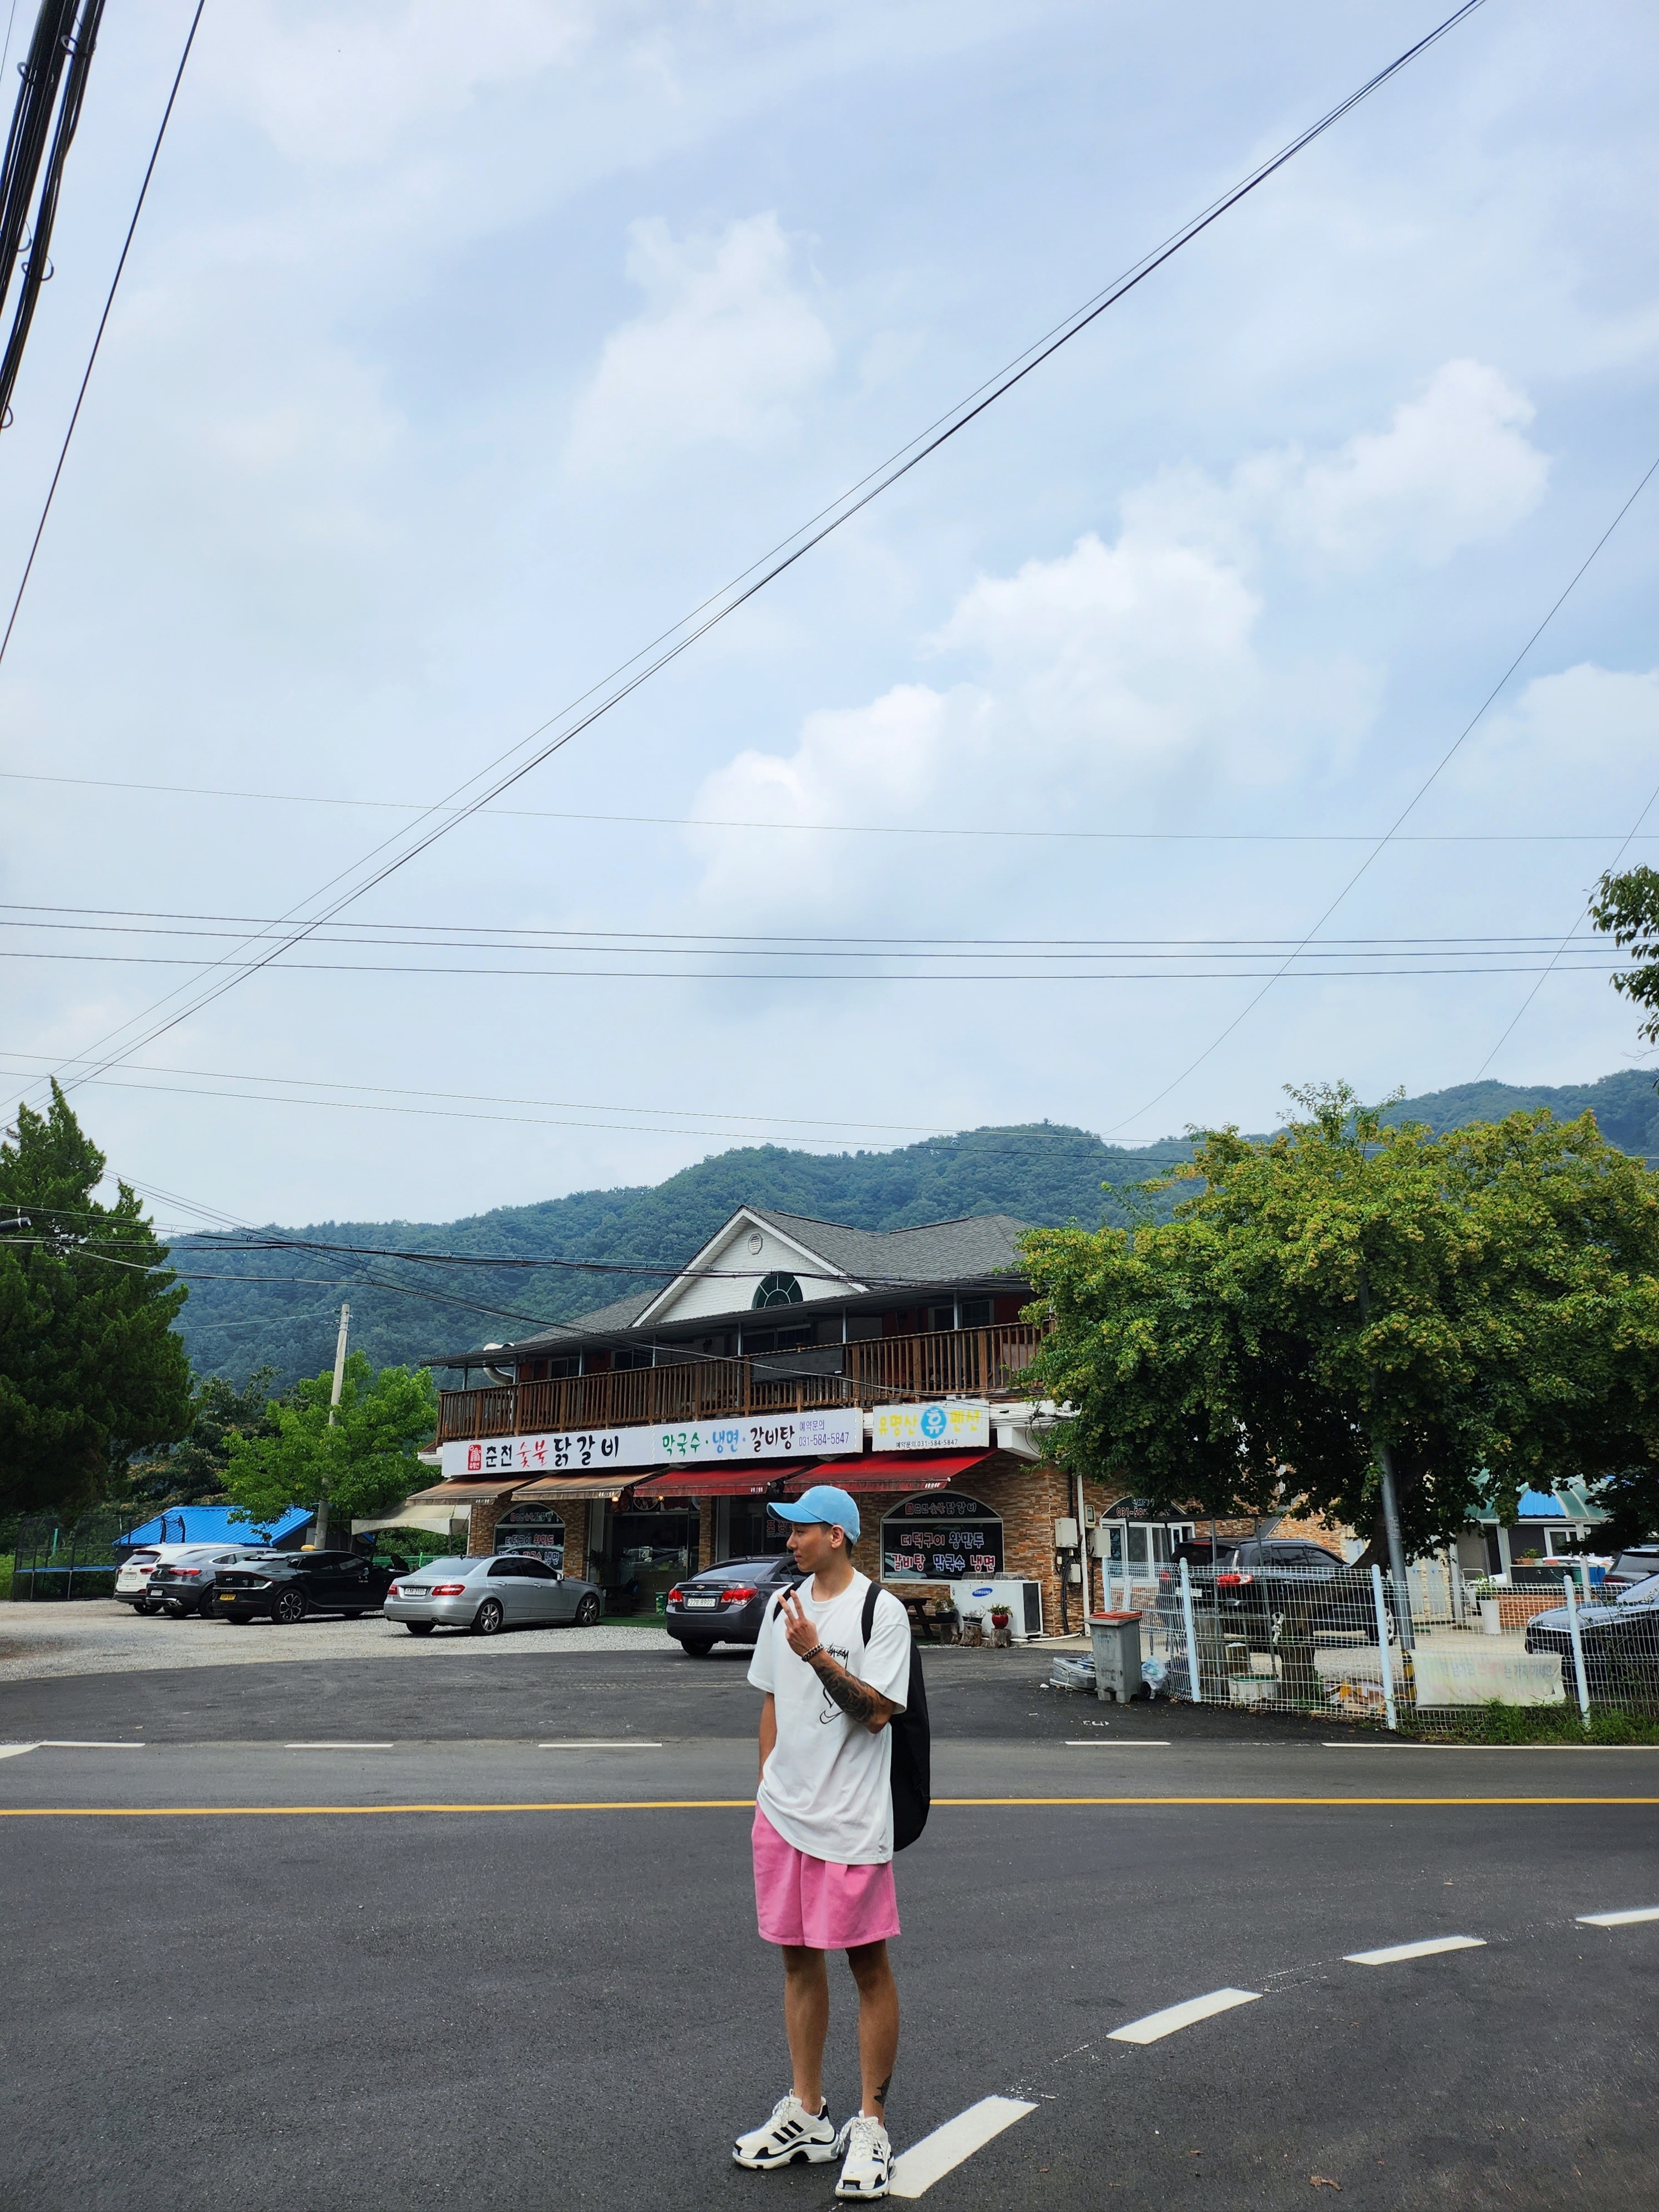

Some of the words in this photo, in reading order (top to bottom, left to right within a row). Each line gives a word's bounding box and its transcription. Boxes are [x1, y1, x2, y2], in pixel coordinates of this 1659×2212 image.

[799, 1420, 825, 1432] 예약문의
[879, 1413, 918, 1437] 유명산
[925, 1409, 943, 1435] 휴
[950, 1409, 981, 1432] 펜션
[662, 1432, 701, 1457] 막국수
[712, 1428, 739, 1454] 냉면
[750, 1425, 795, 1453] 갈비탕
[799, 1432, 849, 1447] 031-584-5847
[485, 1444, 512, 1467] 춘천
[515, 1439, 549, 1468] 숯불
[553, 1434, 620, 1467] 닭갈비
[946, 1501, 977, 1514] 닭갈비
[505, 1534, 531, 1547] 더덕구이
[534, 1534, 554, 1548] 왕만두
[901, 1532, 945, 1549] 더덕구이
[948, 1531, 984, 1549] 왕만두
[545, 1552, 560, 1566] 냉면
[891, 1553, 926, 1572] 갈비탕
[933, 1554, 965, 1572] 막국수
[970, 1554, 996, 1572] 냉면
